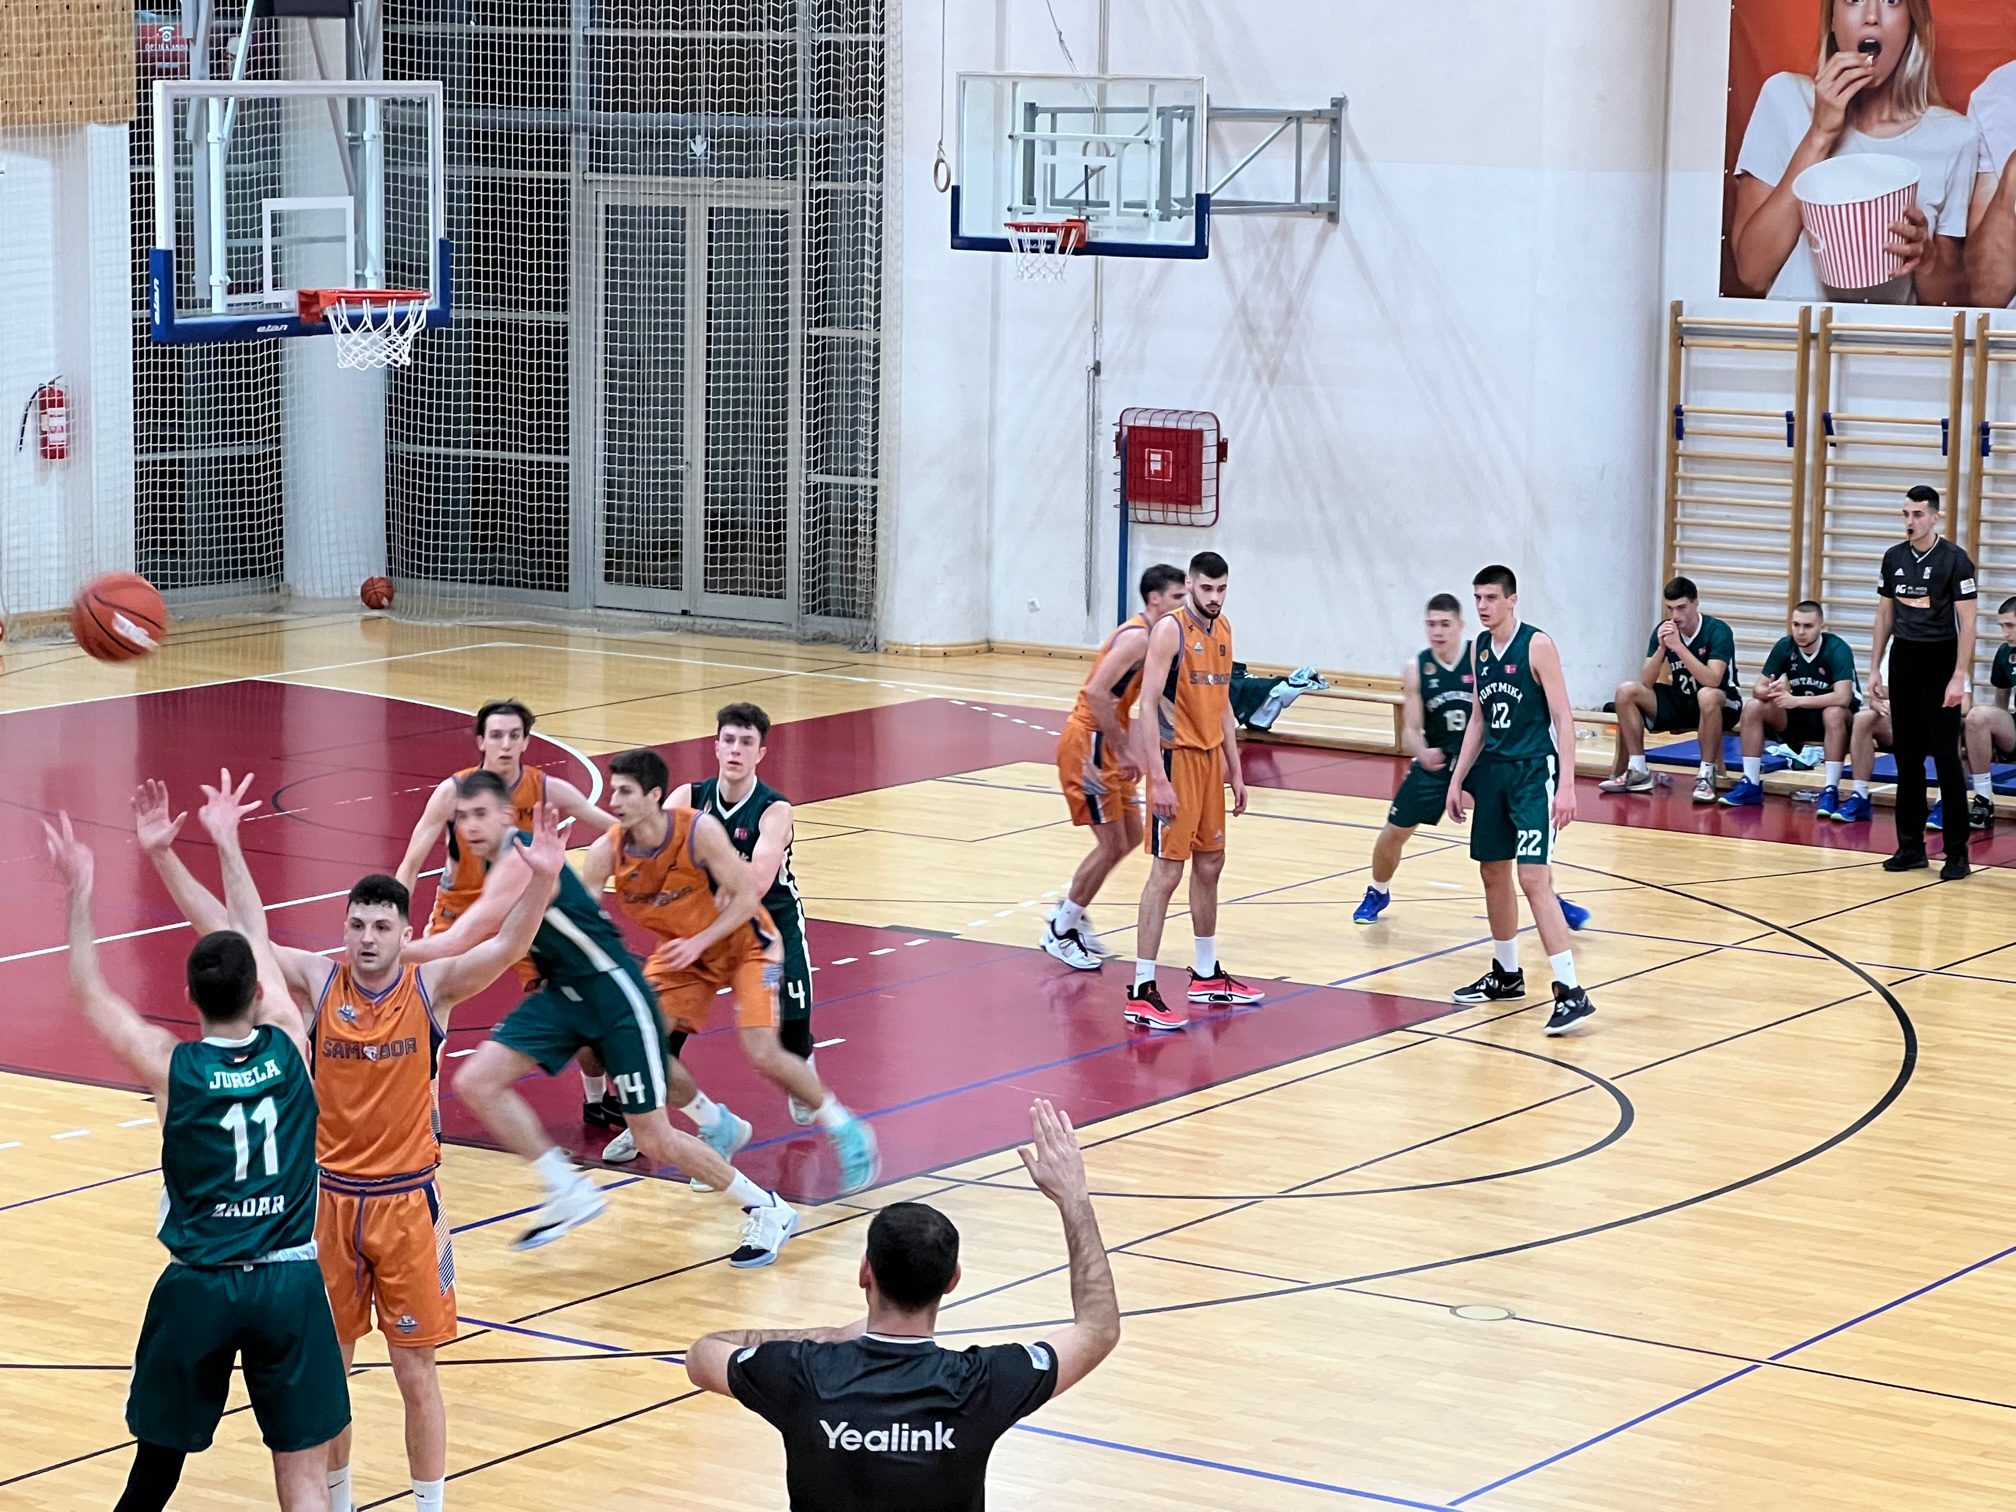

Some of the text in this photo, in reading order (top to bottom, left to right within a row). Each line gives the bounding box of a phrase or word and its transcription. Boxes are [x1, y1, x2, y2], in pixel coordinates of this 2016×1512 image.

[257, 324, 288, 332] elan
[1220, 644, 1226, 656] 9
[1679, 674, 1698, 694] 21
[1491, 702, 1512, 728] 22
[1517, 829, 1542, 856] 22
[787, 979, 806, 1009] 4
[322, 1038, 417, 1061] SAMBOR
[209, 1059, 281, 1089] JURELA
[613, 1071, 646, 1104] 14
[219, 1096, 279, 1182] 11
[211, 1194, 285, 1218] ZADAR
[819, 1419, 956, 1452] Yealink
